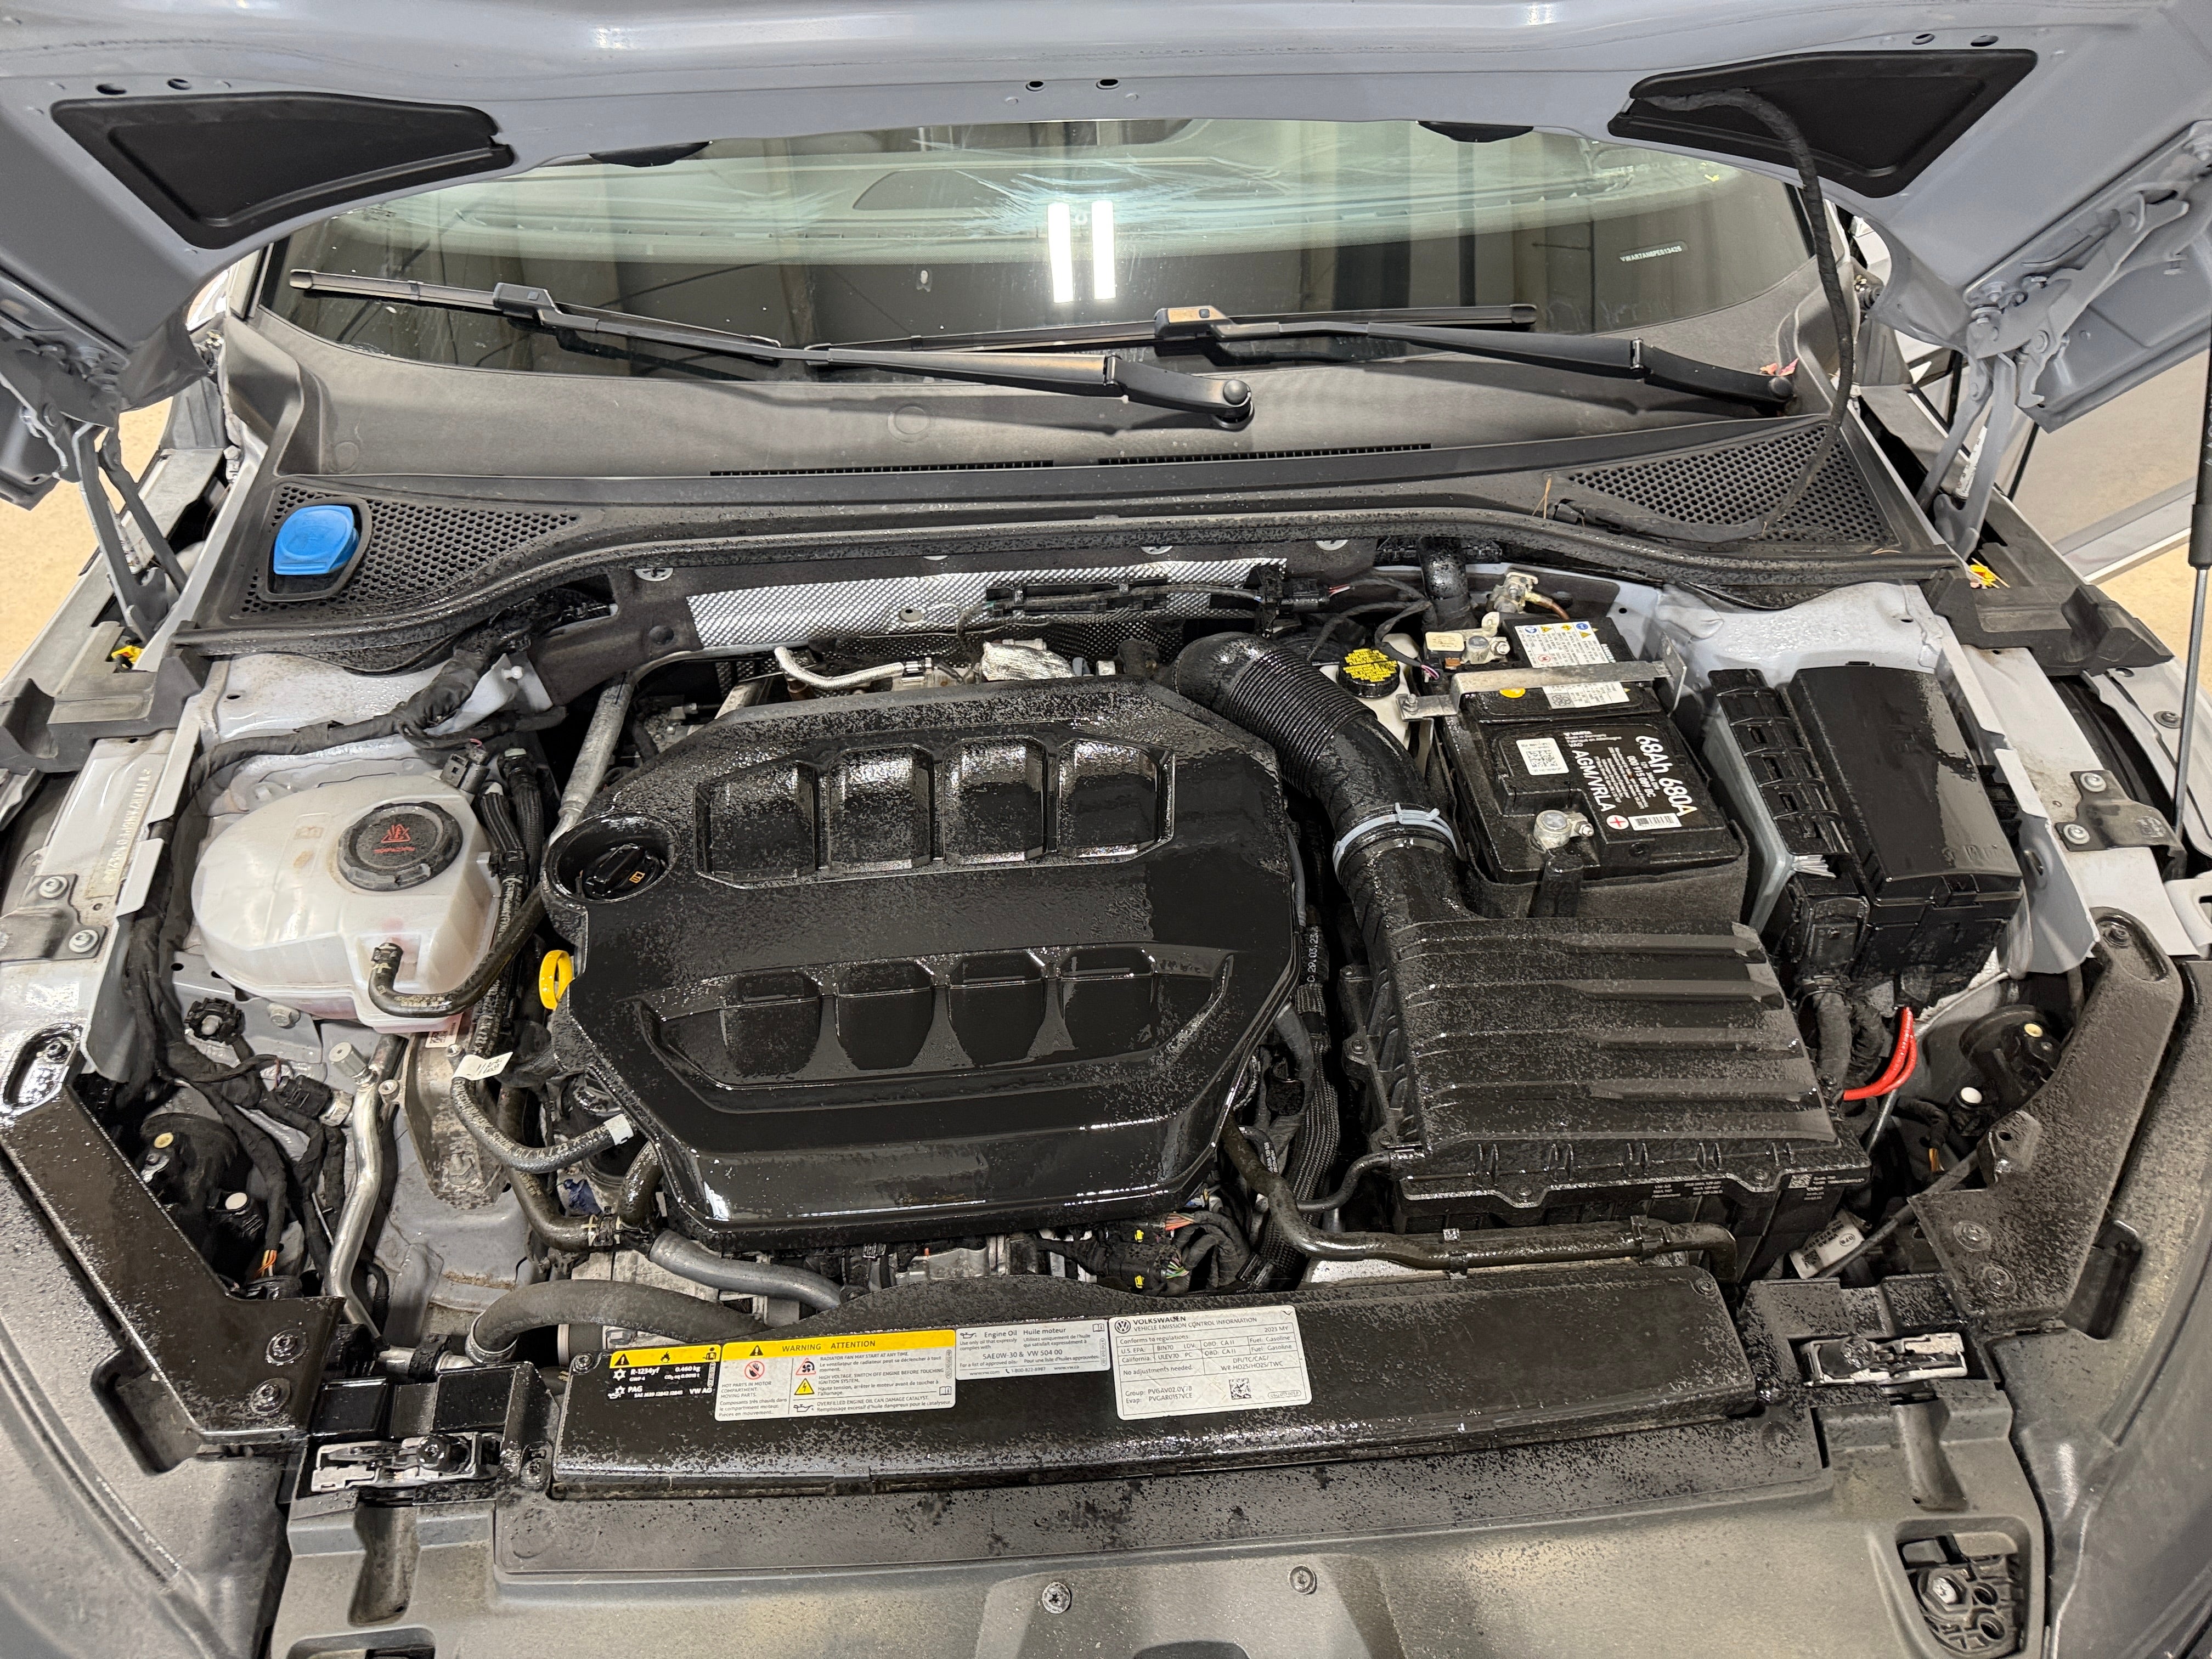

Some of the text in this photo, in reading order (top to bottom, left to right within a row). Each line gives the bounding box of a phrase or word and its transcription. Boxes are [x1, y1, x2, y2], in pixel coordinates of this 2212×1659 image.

[1627, 755, 1639, 766] 000
[1633, 766, 1646, 778] 915
[1644, 789, 1656, 798] BC
[1635, 736, 1697, 816] 68Ah 680A
[1572, 750, 1616, 812] AGM/VRLA
[1132, 1316, 1186, 1325] VOLKSWAGEN
[1156, 1334, 1189, 1342] regulations:
[831, 1340, 875, 1348] ATTENTION
[630, 1367, 661, 1376] R-1234yf
[1133, 1366, 1170, 1375] adjustments
